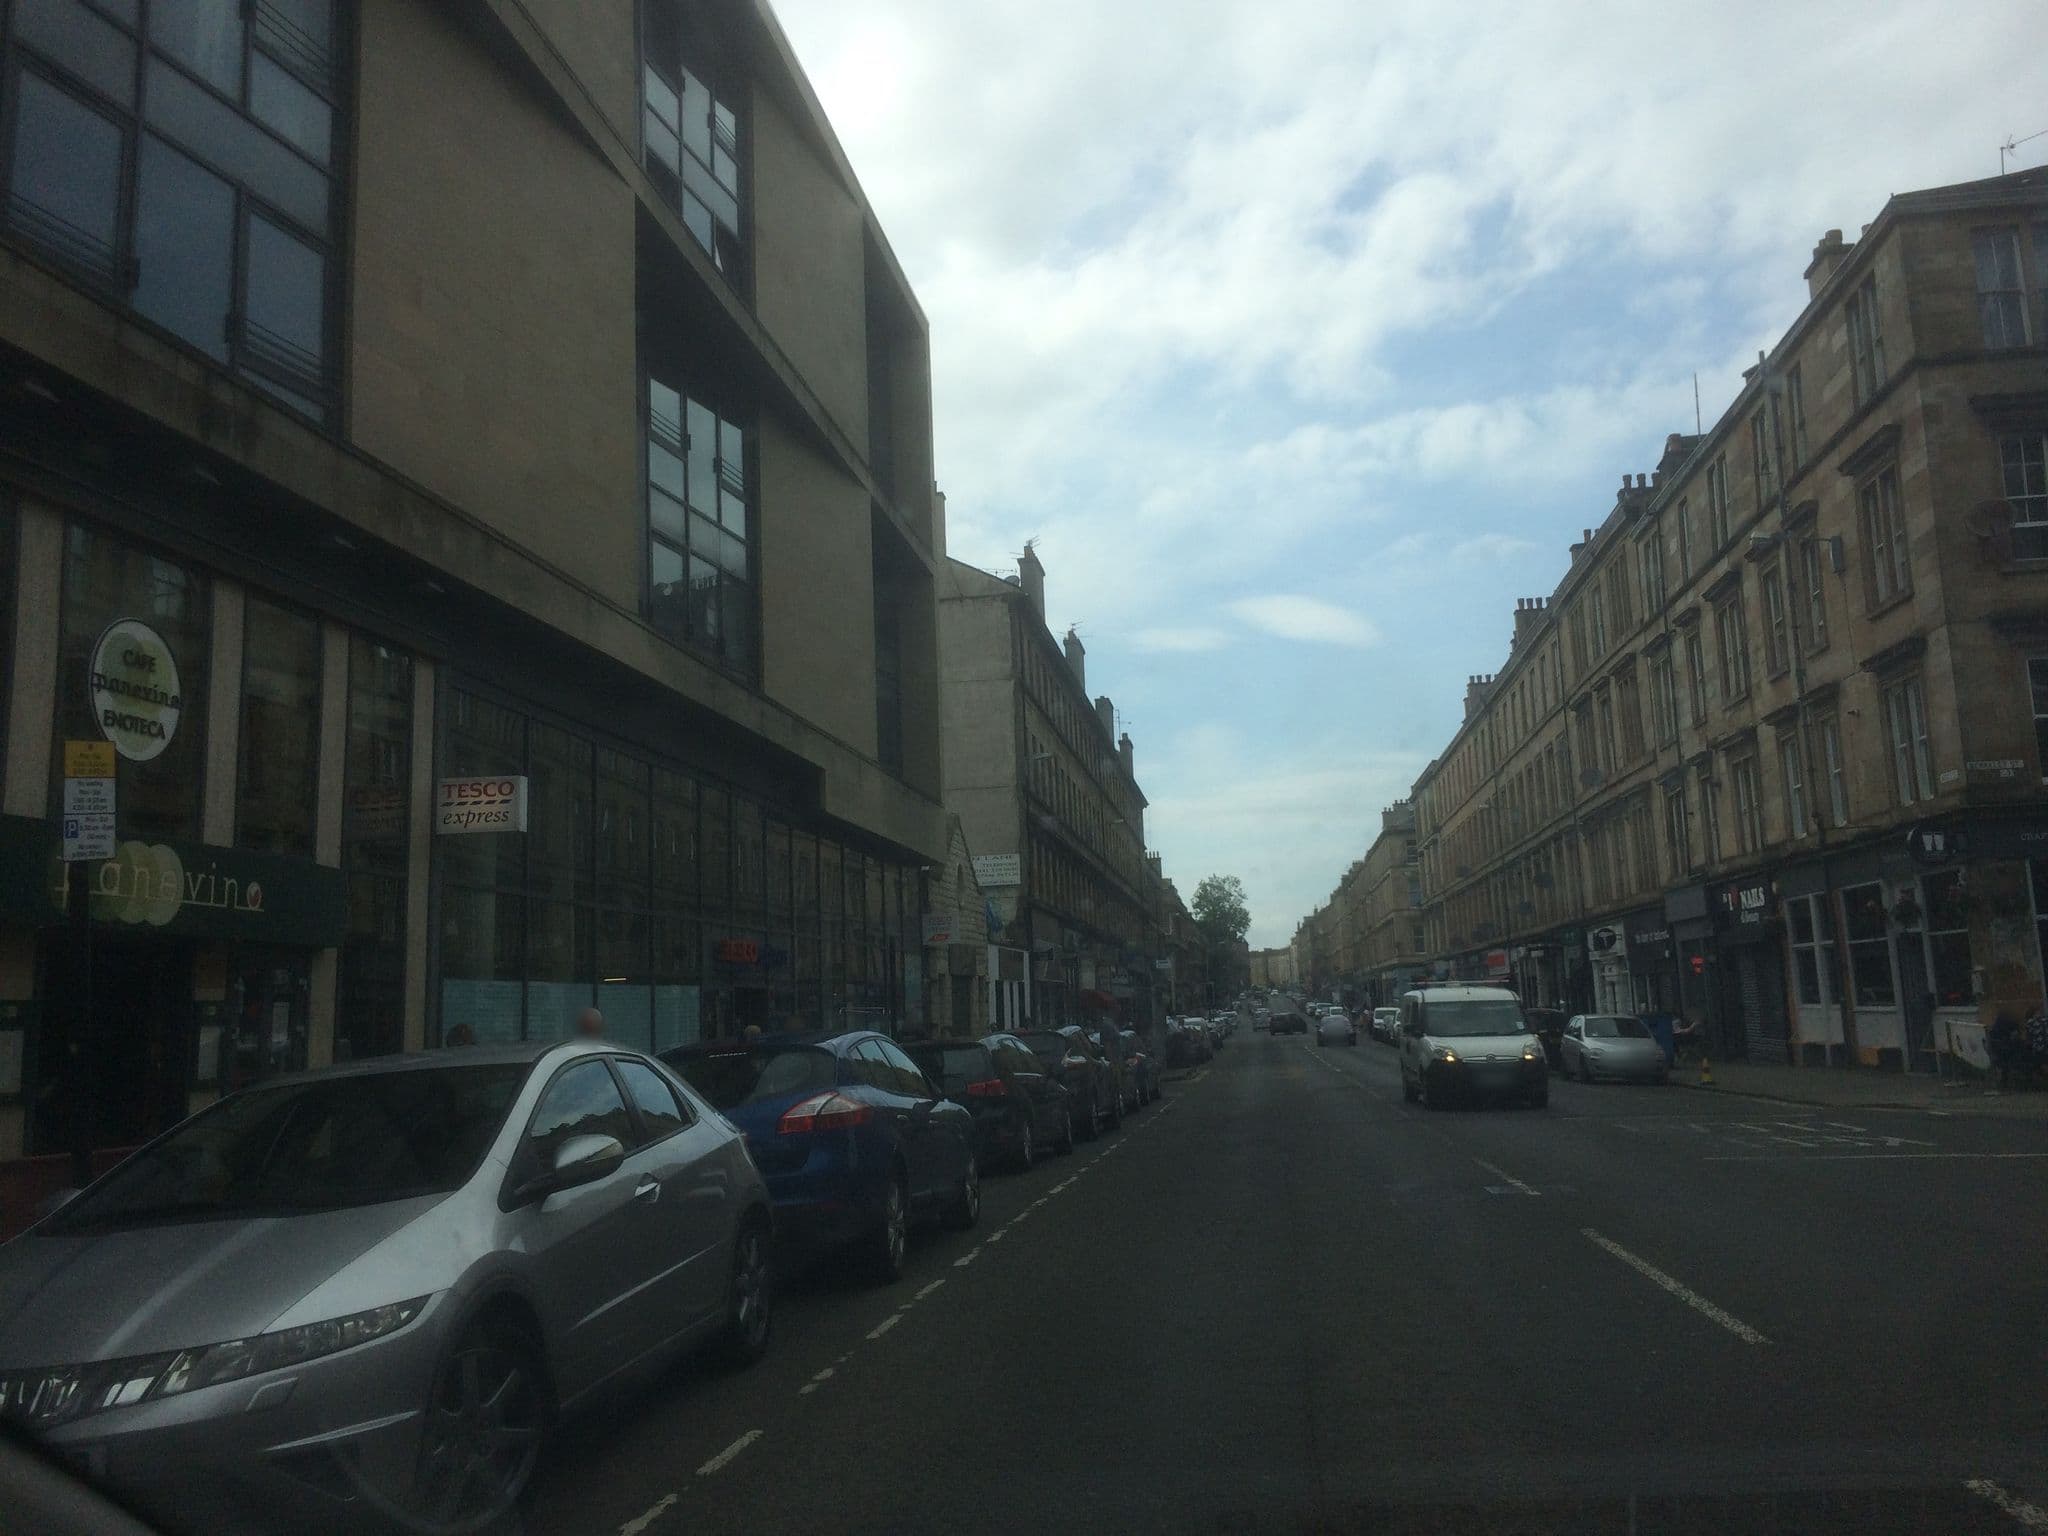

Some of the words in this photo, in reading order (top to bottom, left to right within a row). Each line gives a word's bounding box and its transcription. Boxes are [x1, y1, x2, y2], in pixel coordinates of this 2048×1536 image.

[104, 710, 166, 739] ENOTECA
[442, 781, 515, 799] TESCO
[443, 809, 510, 829] express
[1739, 886, 1766, 910] NAILS
